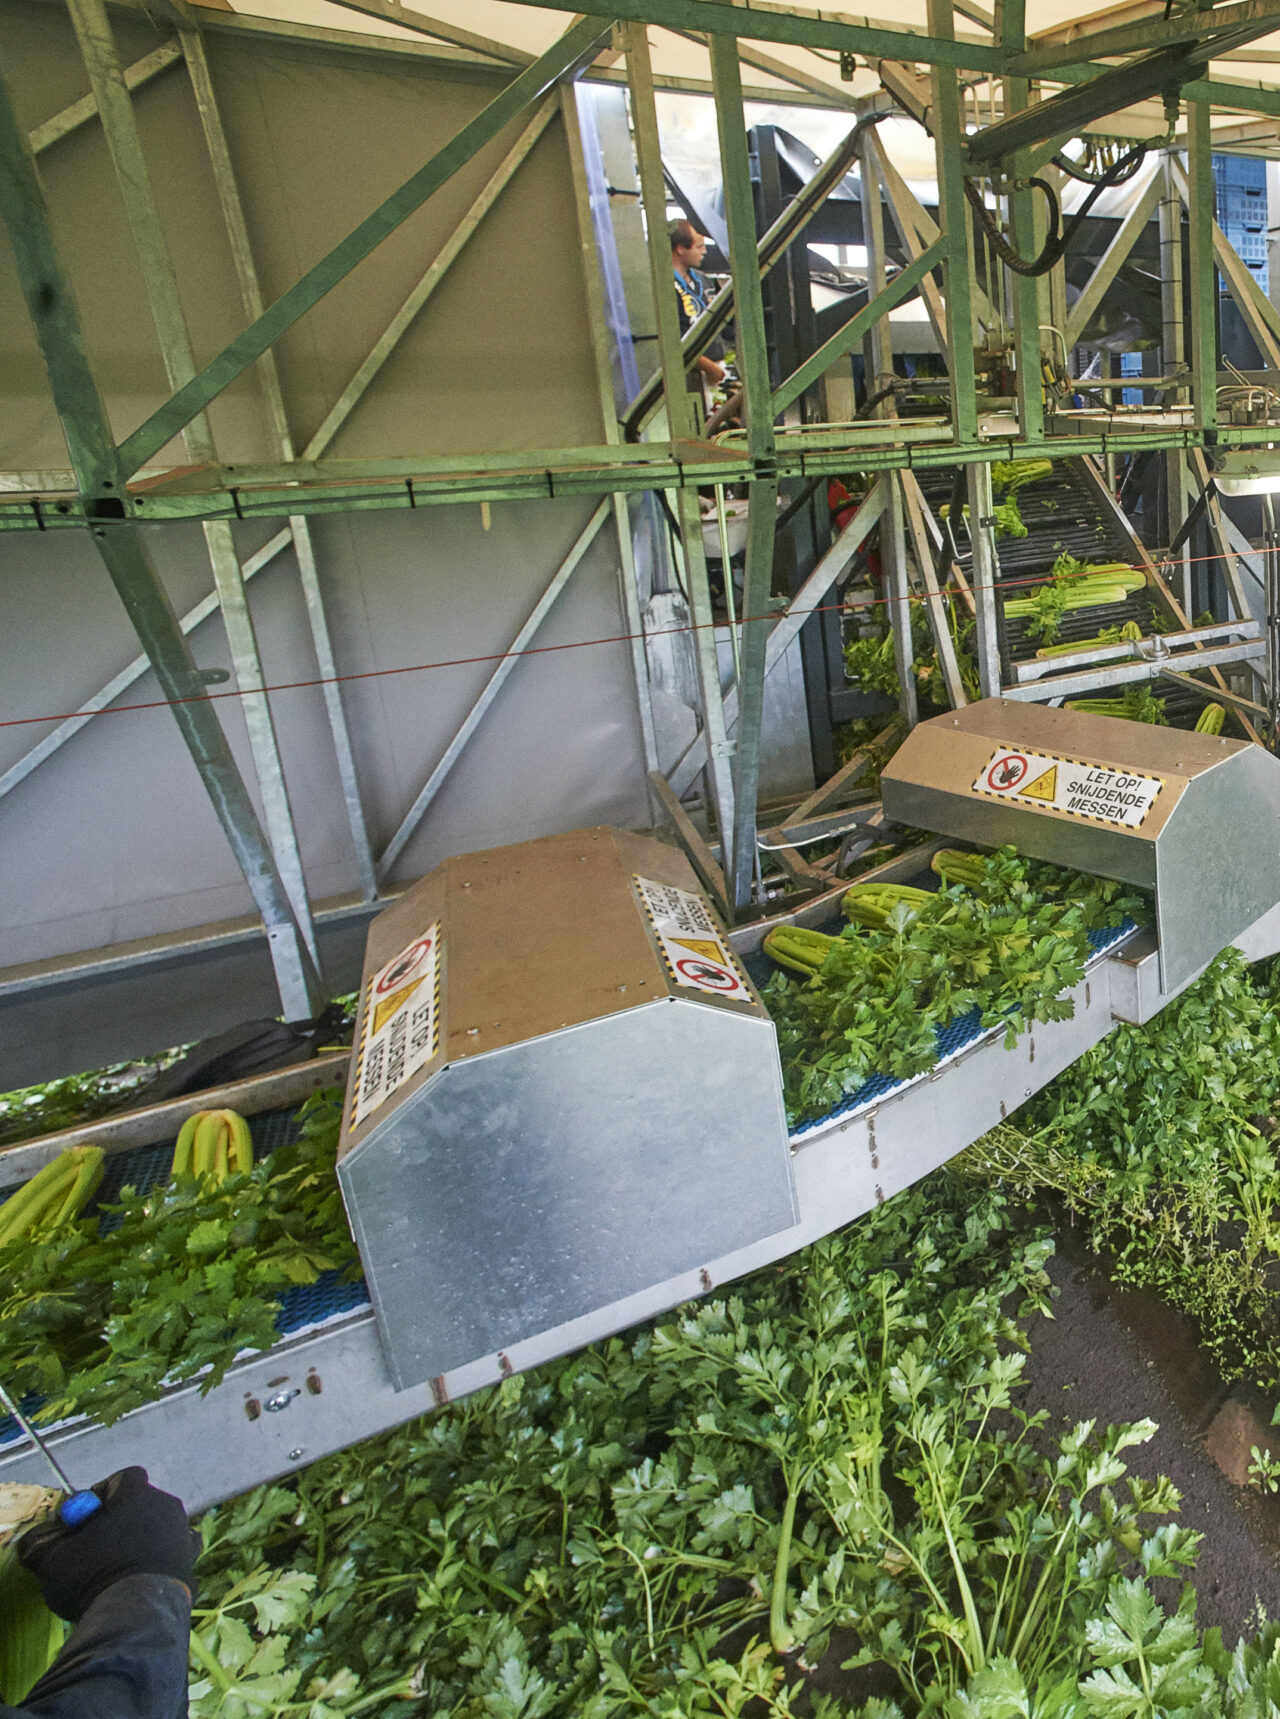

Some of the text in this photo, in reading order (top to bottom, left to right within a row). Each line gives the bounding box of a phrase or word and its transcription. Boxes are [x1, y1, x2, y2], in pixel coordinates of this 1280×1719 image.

[1066, 781, 1147, 808] SNIJDENDE
[1086, 771, 1142, 791] LET OP!
[1067, 797, 1128, 820] MESSEN
[651, 901, 671, 919] LET
[662, 887, 695, 933] SNIJDENDE
[684, 898, 713, 933] MESSEN
[410, 1000, 430, 1058] LET OP!
[386, 1010, 408, 1091] SNIJDENDE
[363, 1038, 385, 1103] MESSEN
